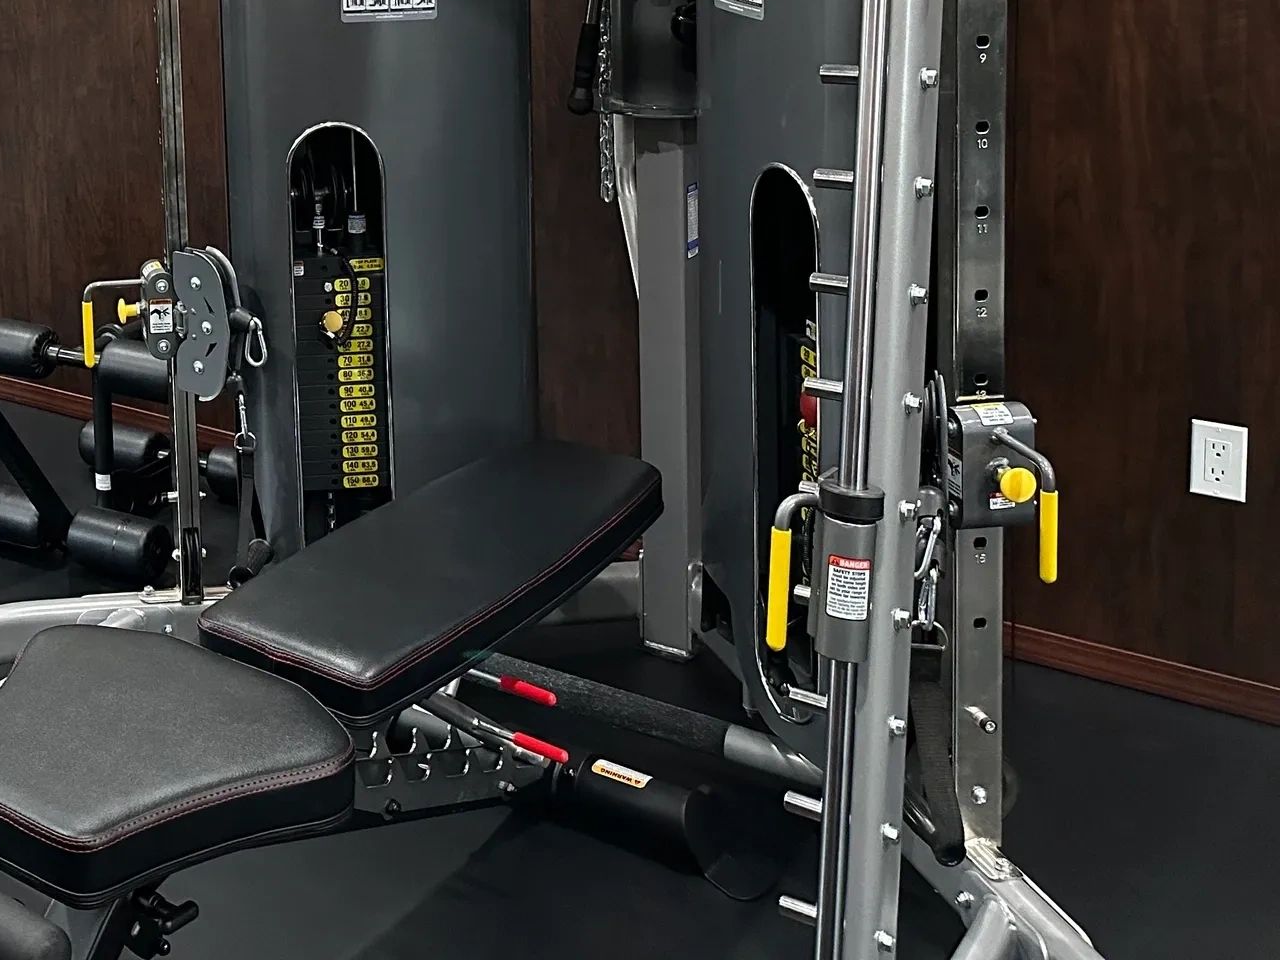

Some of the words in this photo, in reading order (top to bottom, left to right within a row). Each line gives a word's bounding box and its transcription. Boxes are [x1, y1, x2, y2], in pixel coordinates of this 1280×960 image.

[980, 53, 987, 64] 9
[977, 139, 988, 148] 10
[978, 224, 987, 234] 11
[976, 307, 988, 317] 12
[343, 356, 352, 364] 70
[975, 553, 986, 563] 15
[840, 560, 870, 570] DANGER
[600, 768, 632, 782] WARNING
